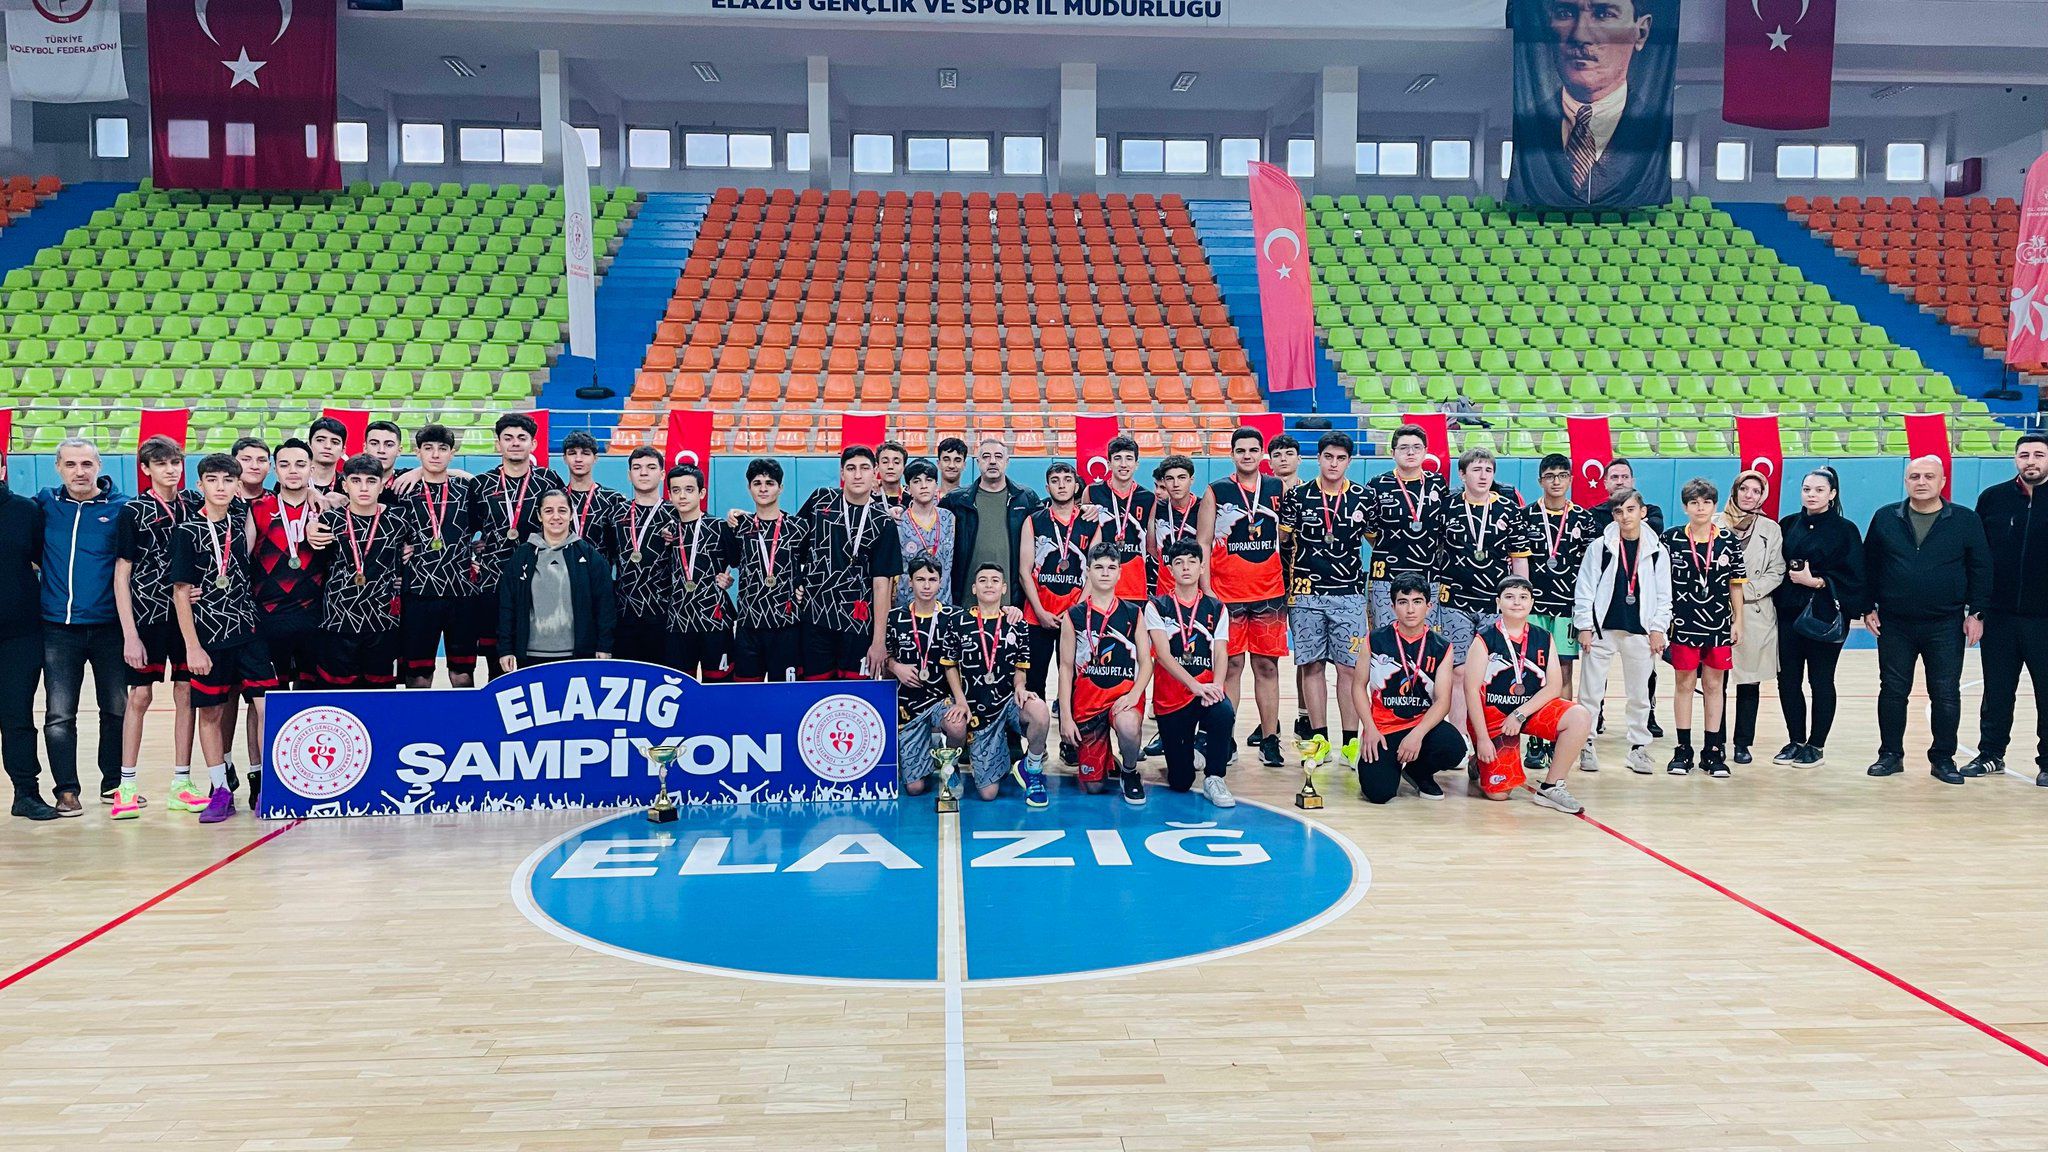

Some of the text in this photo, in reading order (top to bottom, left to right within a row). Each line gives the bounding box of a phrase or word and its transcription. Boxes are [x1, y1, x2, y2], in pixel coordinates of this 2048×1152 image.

[926, 0, 956, 14] VE
[961, 0, 1030, 15] SPOR
[10, 44, 54, 54] VOLEYBOL
[1228, 541, 1260, 552] TOPRAKSU
[1372, 561, 1386, 578] 13
[1293, 577, 1312, 595] 23
[1348, 637, 1365, 654] 2
[718, 653, 730, 672] 4
[1425, 655, 1436, 673] 11
[1537, 649, 1546, 667] 6
[785, 666, 796, 682] 6
[495, 675, 683, 734] ELAZIĞ
[1487, 692, 1520, 705] TOPRAKSU
[396, 728, 782, 795] ŞAMPİYON
